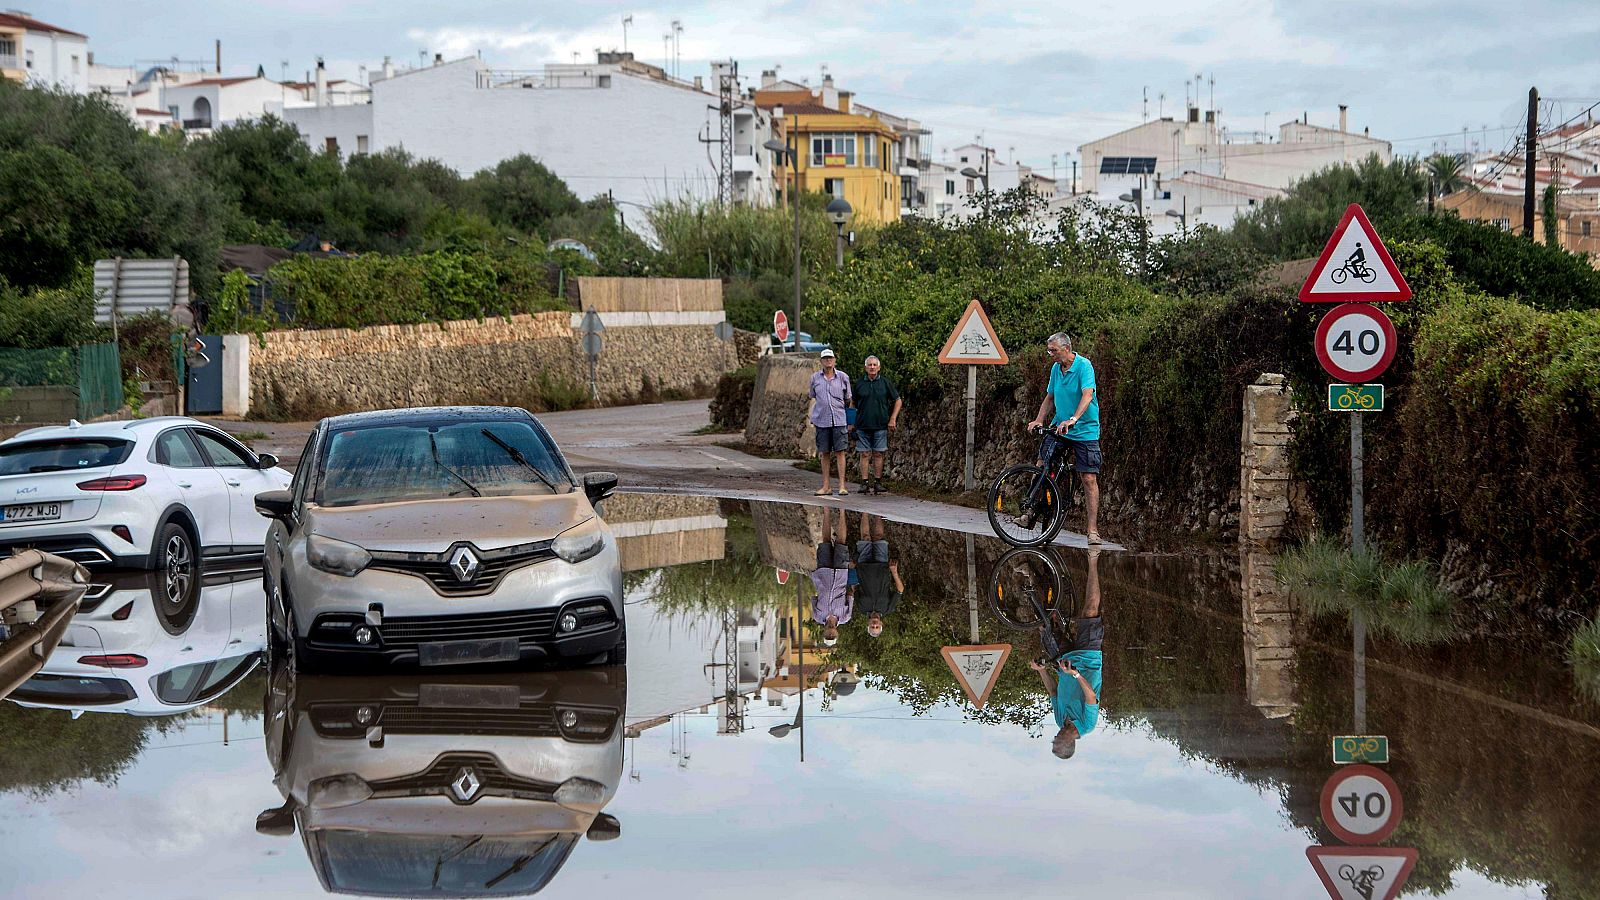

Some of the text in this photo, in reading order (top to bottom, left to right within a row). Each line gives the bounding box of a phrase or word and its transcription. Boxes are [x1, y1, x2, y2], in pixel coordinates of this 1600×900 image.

[776, 321, 787, 331] STOP
[1333, 329, 1379, 356] 40
[6, 504, 59, 518] 4772 MJD
